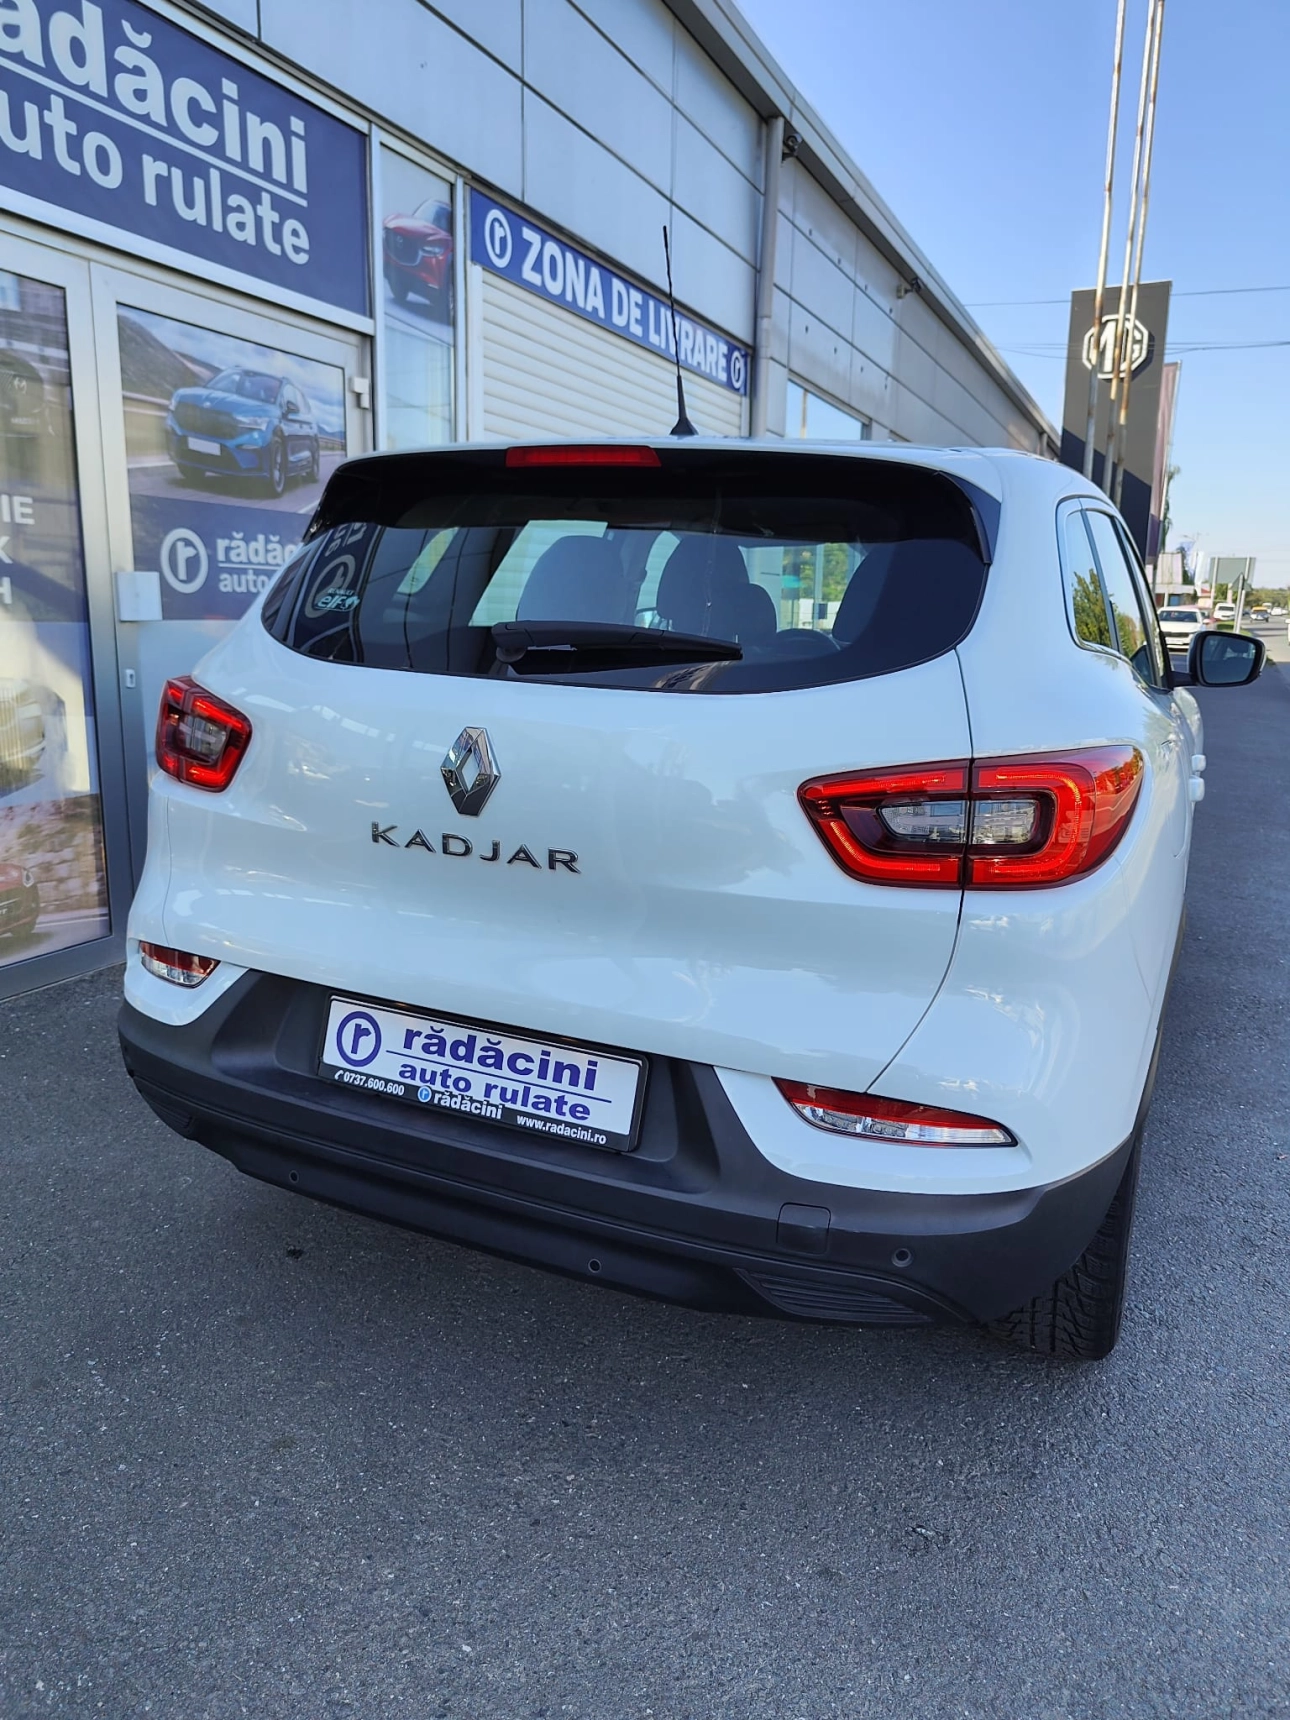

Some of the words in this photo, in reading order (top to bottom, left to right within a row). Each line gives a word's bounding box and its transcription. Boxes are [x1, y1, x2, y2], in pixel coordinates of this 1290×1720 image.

[142, 153, 309, 265] rulate
[522, 226, 605, 319] ZONA
[612, 277, 643, 337] DE
[649, 299, 729, 383] LIVRARE
[371, 820, 582, 875] KADJAR
[343, 1071, 405, 1096] 0737.600.600
[403, 1025, 598, 1092] rădăcini
[398, 1063, 472, 1093] auto
[483, 1082, 591, 1121] rulate
[433, 1091, 503, 1120] rădăcini
[516, 1114, 607, 1145] www.radacini.ro
